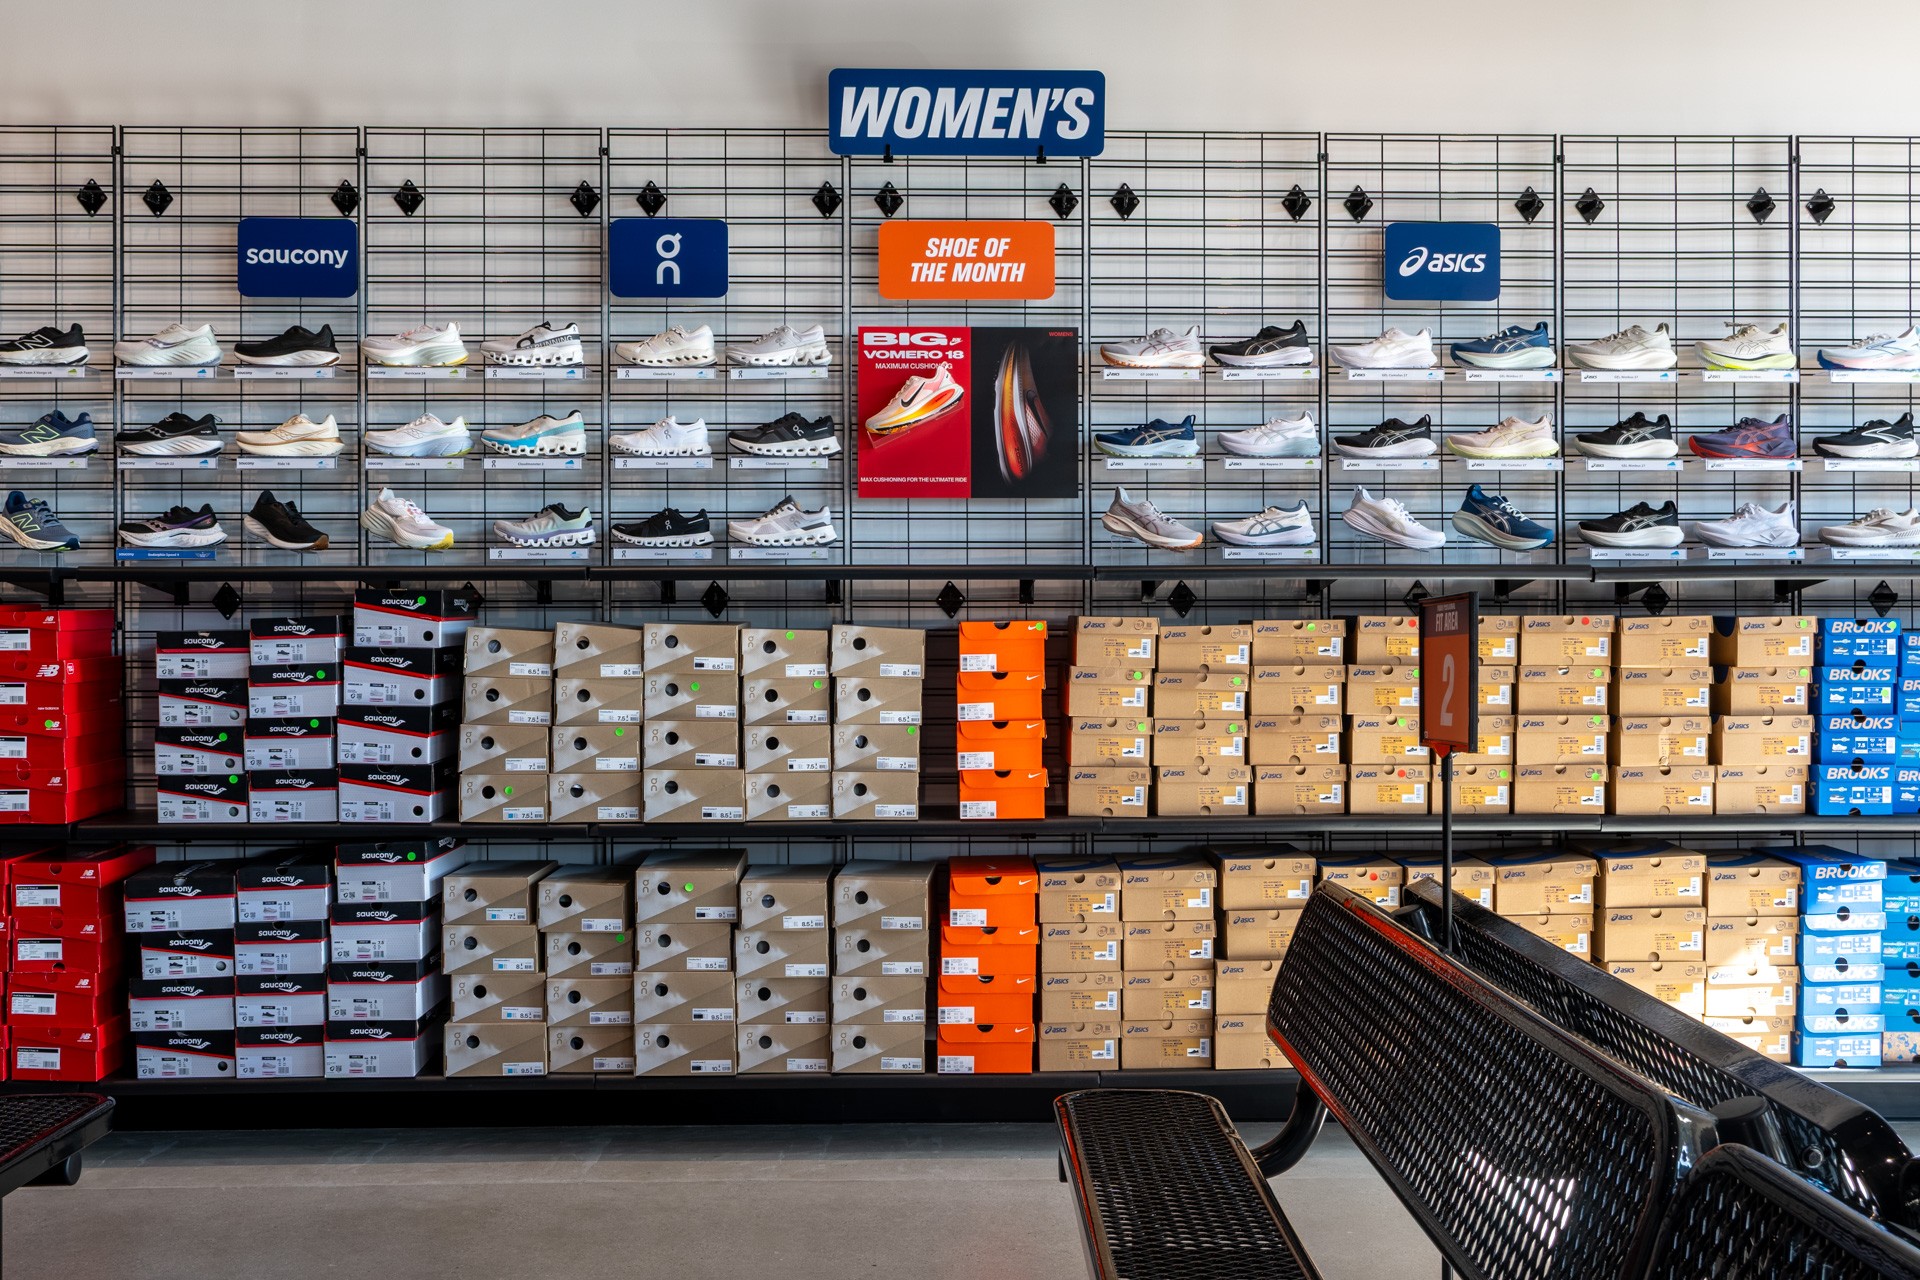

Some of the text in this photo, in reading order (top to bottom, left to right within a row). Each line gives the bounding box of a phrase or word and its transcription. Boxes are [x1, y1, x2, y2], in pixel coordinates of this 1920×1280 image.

[840, 87, 1094, 139] WOMEN'S
[925, 238, 1010, 258] SHOE OF
[246, 248, 348, 268] saucony
[911, 263, 1025, 283] THE MONTH
[864, 333, 948, 345] BIG
[864, 350, 964, 359] VOMERO 18
[1444, 611, 1458, 631] AREA
[1832, 622, 1896, 633] BROOKS
[1829, 669, 1891, 680] BROOKS
[1440, 654, 1455, 726] 2
[1829, 718, 1894, 729] BROOKS
[1827, 768, 1889, 780] BROOKS
[1815, 865, 1879, 879] BROOKS
[1814, 967, 1877, 980] BROOKS
[1814, 1018, 1878, 1031] BROOKS
